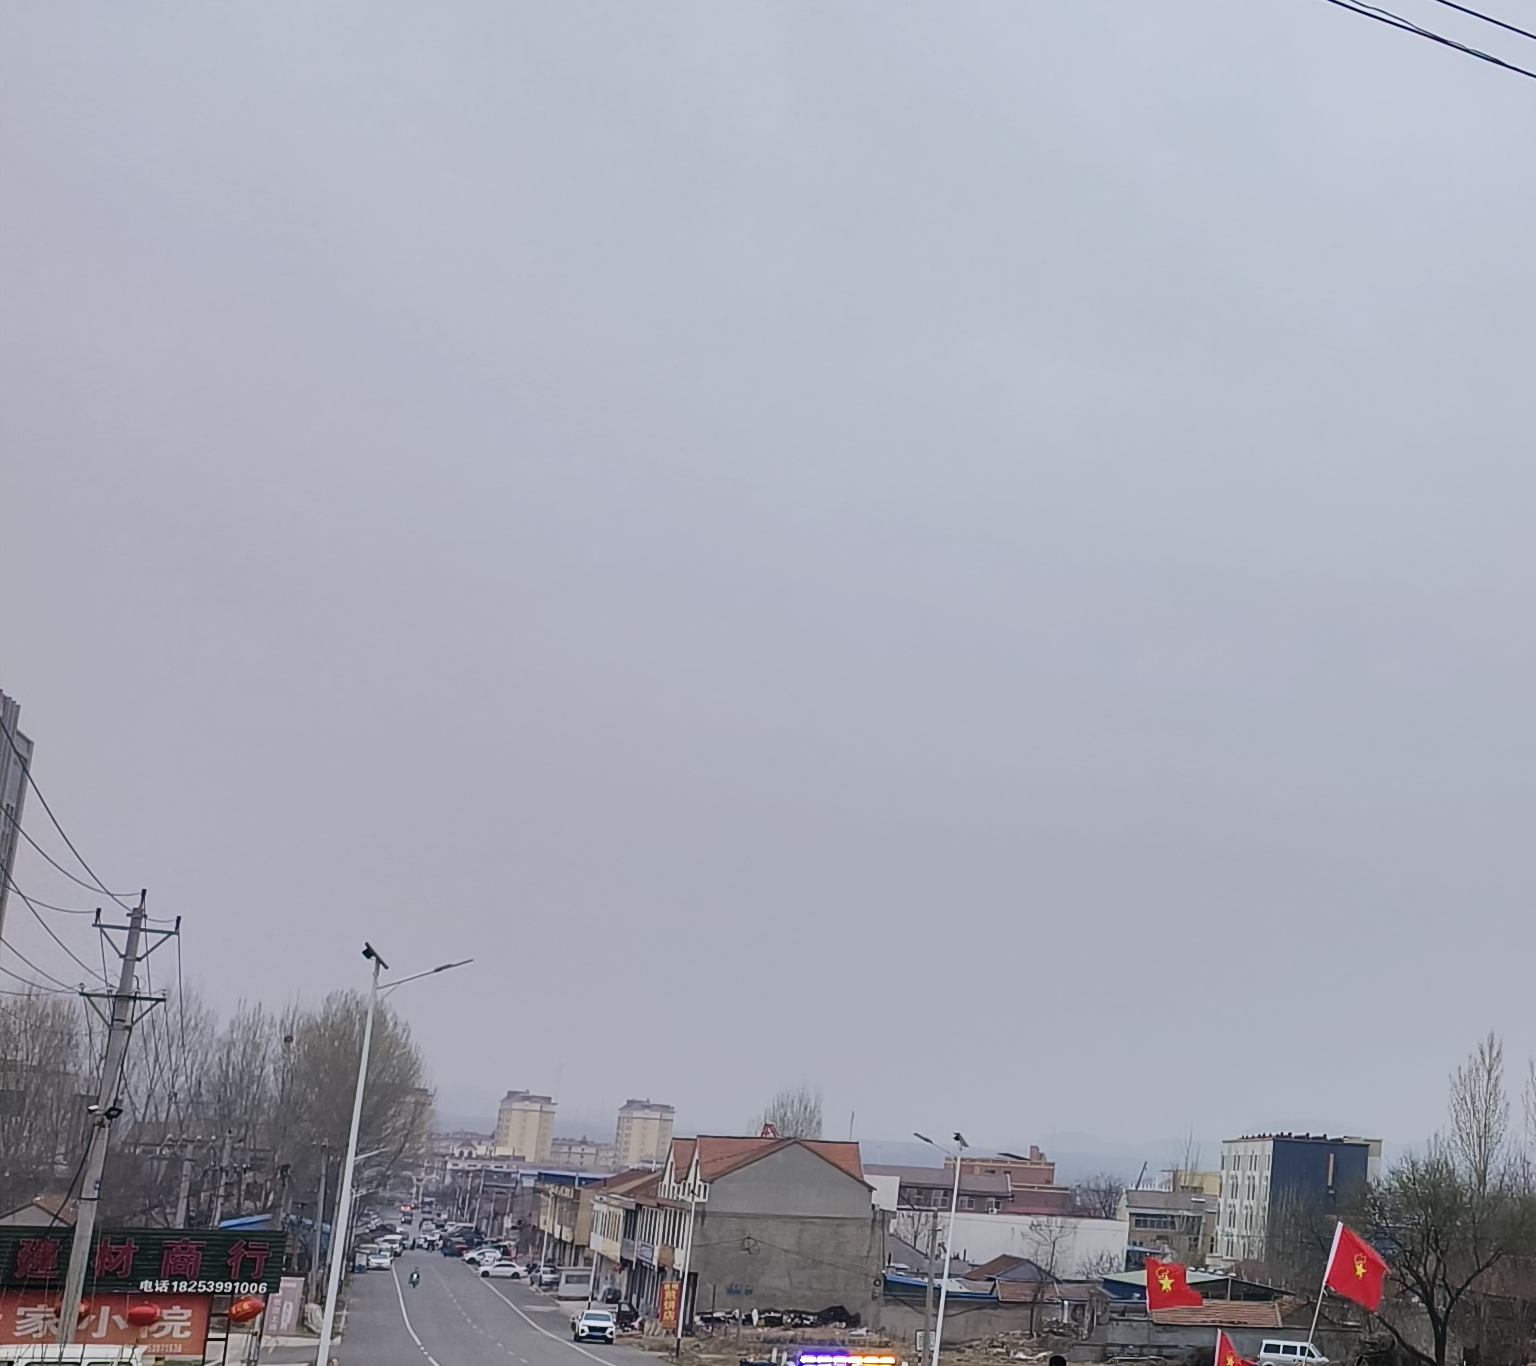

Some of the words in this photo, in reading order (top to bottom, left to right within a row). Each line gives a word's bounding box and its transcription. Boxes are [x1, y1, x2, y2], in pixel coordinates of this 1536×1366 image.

[14, 1237, 273, 1280] 建材商行
[139, 1279, 268, 1294] 电话18253991006
[0, 1304, 192, 1339] 家小院
